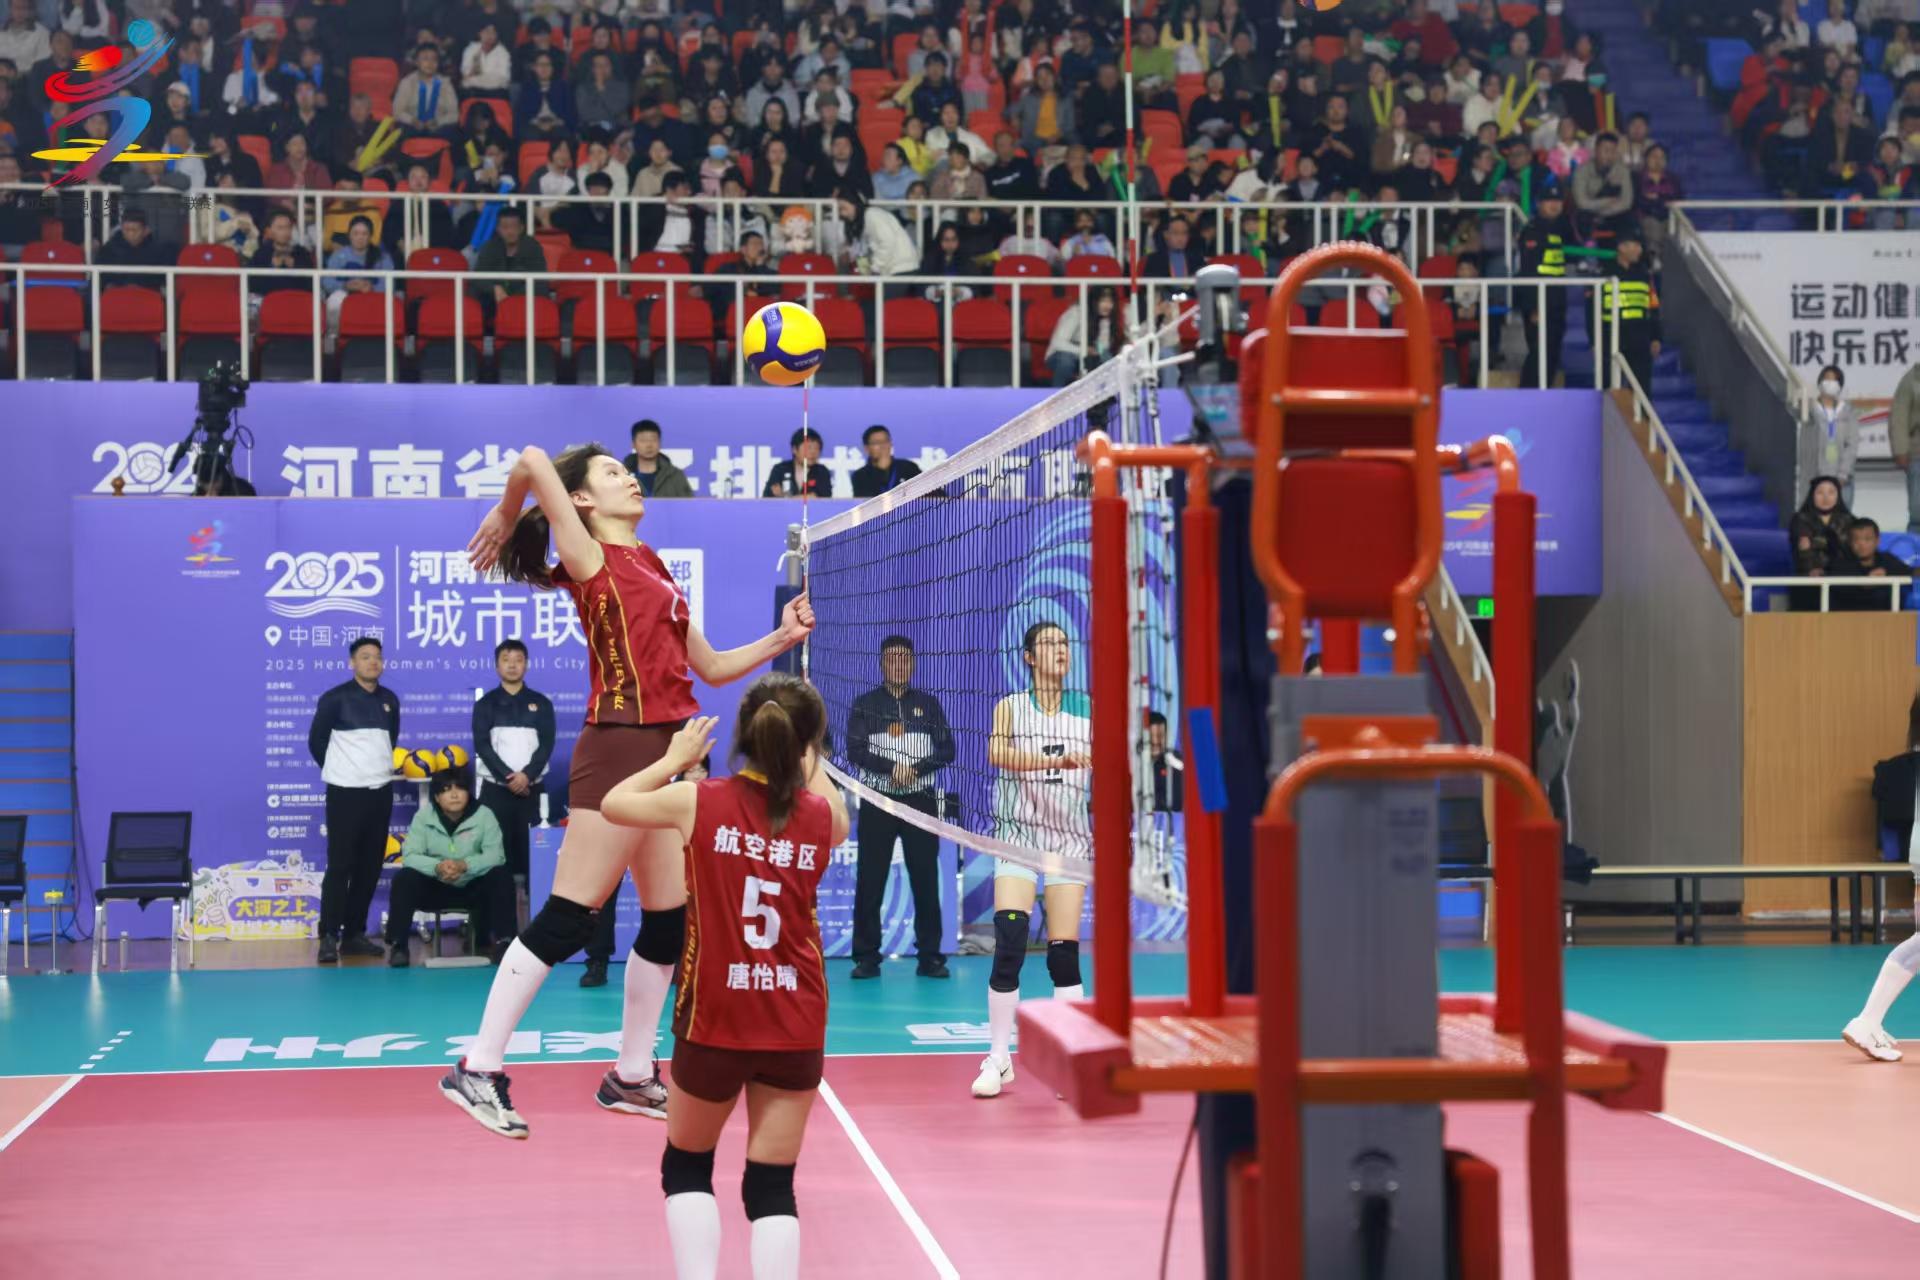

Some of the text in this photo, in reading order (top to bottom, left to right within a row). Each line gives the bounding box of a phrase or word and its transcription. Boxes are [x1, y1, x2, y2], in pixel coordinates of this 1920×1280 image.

[1791, 283, 1920, 319] 运动健
[1790, 328, 1920, 366] 快乐成
[92, 441, 198, 493] 202
[265, 551, 384, 597] 2025
[407, 589, 588, 648] 城市联
[265, 659, 305, 670] 2025
[384, 657, 450, 670] omen's
[554, 657, 585, 670] City
[713, 825, 817, 871] 航空港区
[742, 876, 782, 950] 5
